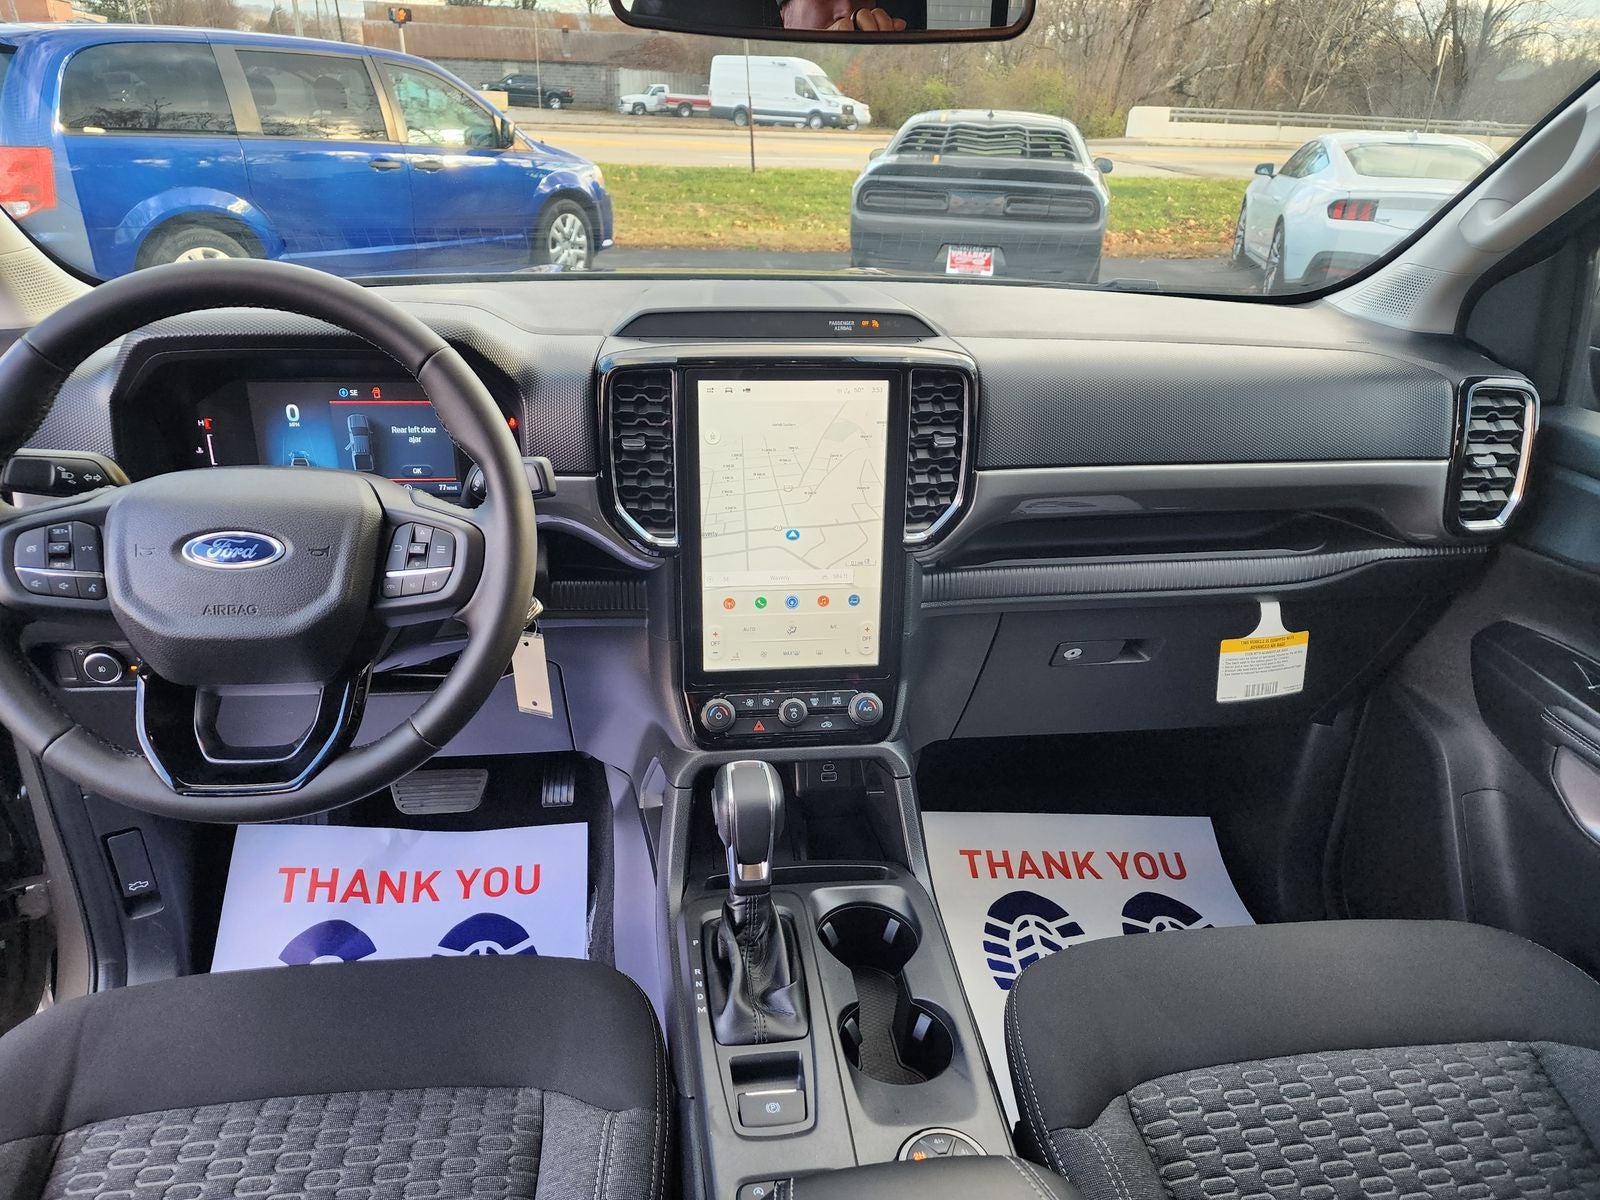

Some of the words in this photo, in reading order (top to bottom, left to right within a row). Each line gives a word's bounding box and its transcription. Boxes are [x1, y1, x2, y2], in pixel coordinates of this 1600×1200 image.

[285, 403, 300, 422] 0
[408, 425, 421, 433] left
[421, 425, 437, 433] door
[408, 436, 422, 444] ajar
[206, 538, 260, 560] Ford
[202, 603, 259, 617] AIRBAG
[959, 849, 1103, 880] THANK
[1106, 851, 1187, 880] YOU
[278, 867, 442, 904] THANK
[456, 863, 541, 900] YOU
